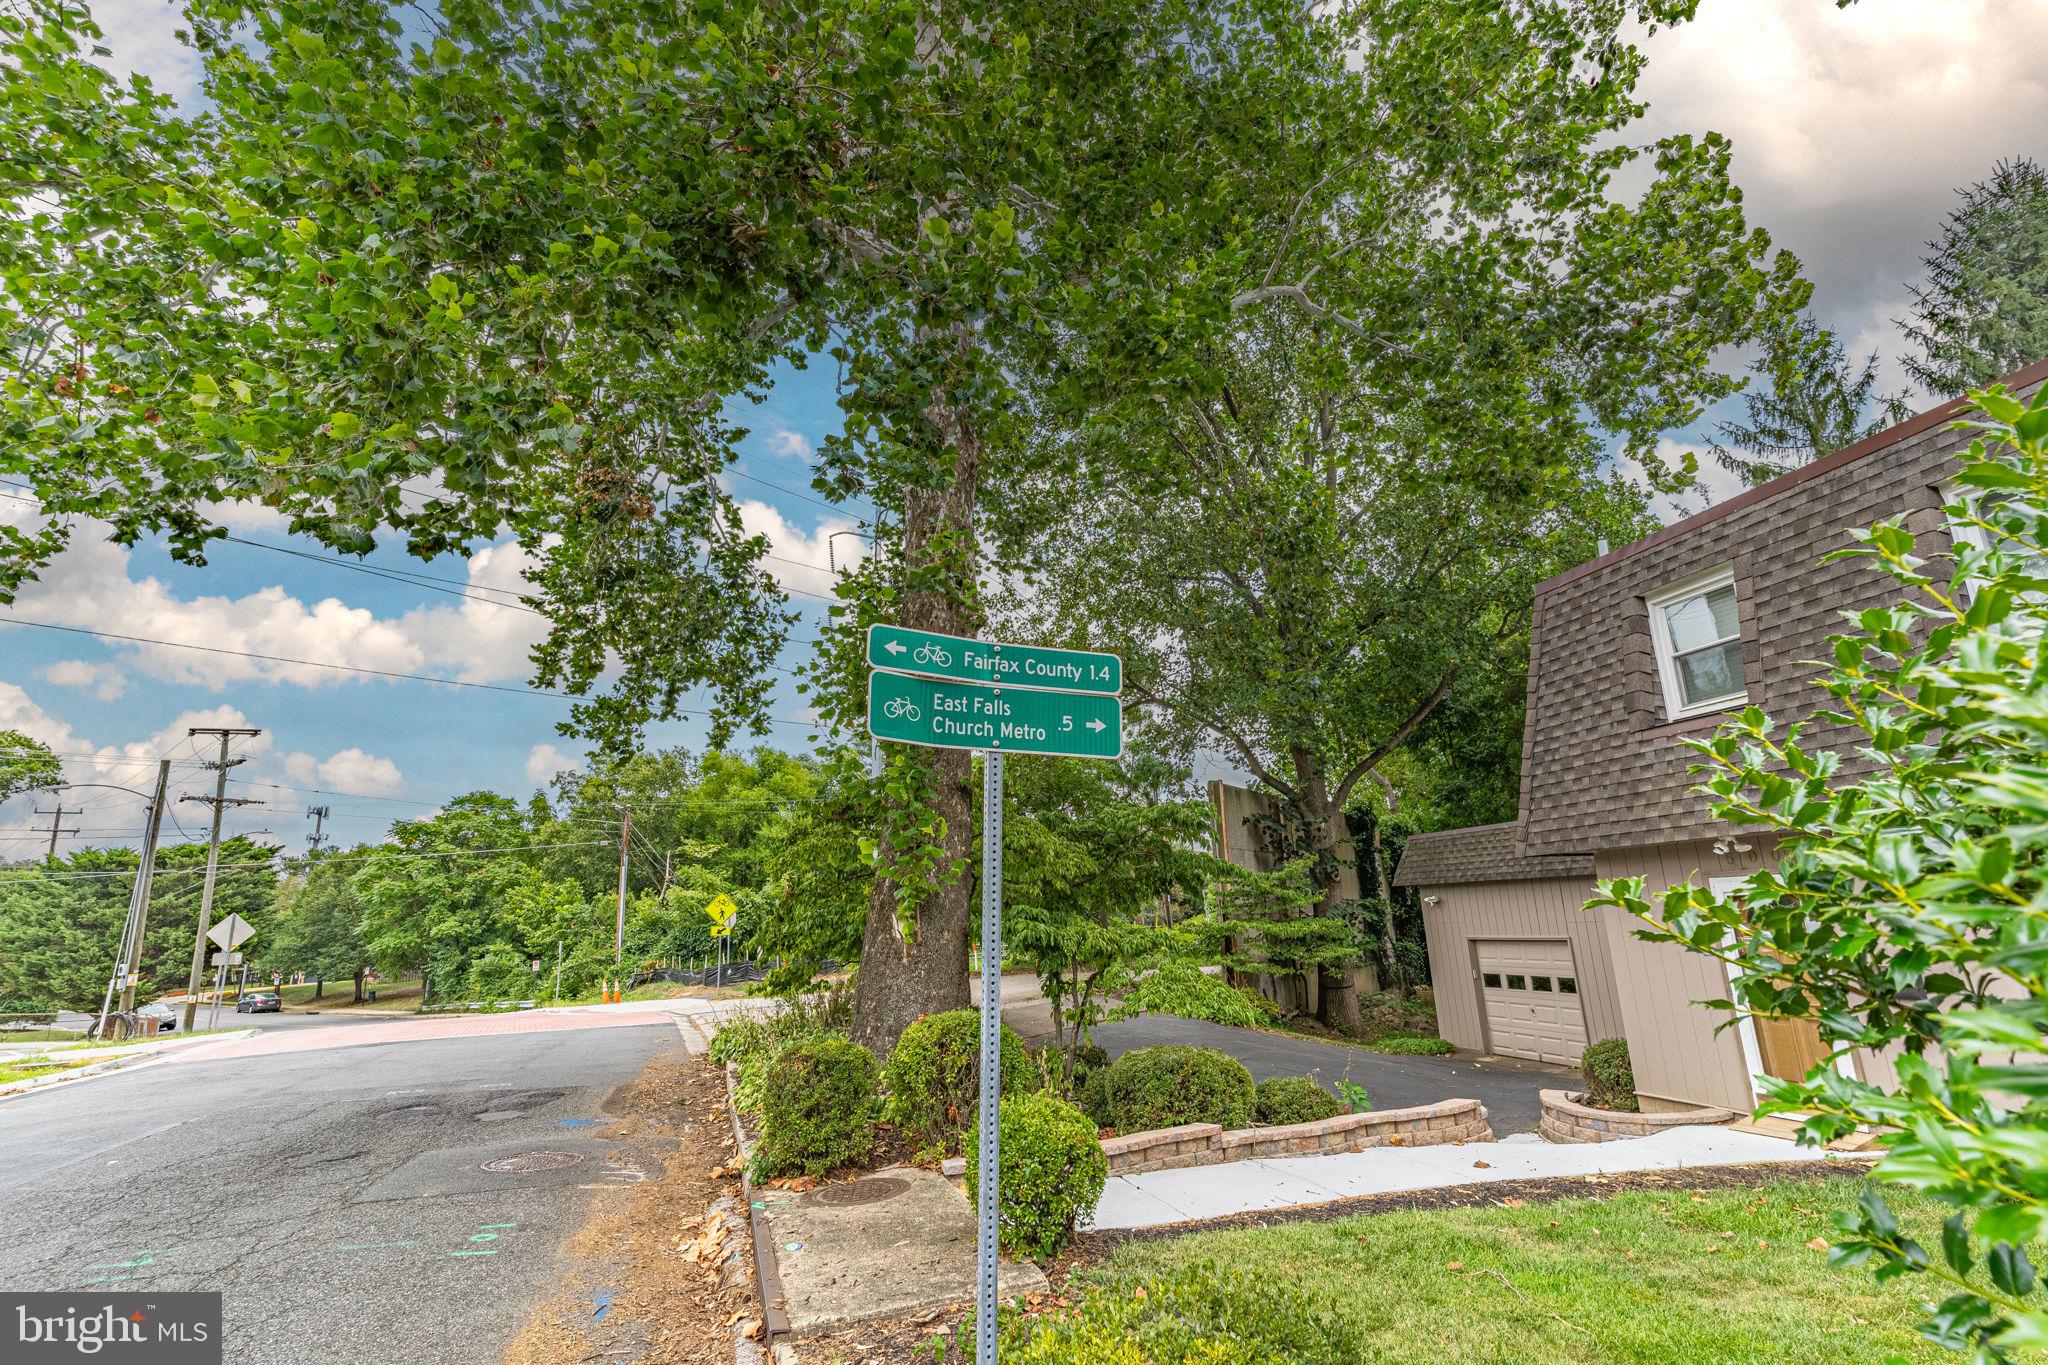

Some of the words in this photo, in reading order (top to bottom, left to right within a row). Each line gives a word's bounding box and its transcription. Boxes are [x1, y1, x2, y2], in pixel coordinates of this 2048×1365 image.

[963, 651, 1020, 674] Fairfax
[1025, 659, 1082, 682] County
[1089, 664, 1110, 682] 1.4
[934, 693, 968, 713] East
[973, 697, 1011, 717] Falls
[932, 717, 994, 737] Church
[1000, 722, 1046, 741] Metro
[1057, 715, 1073, 732] .5
